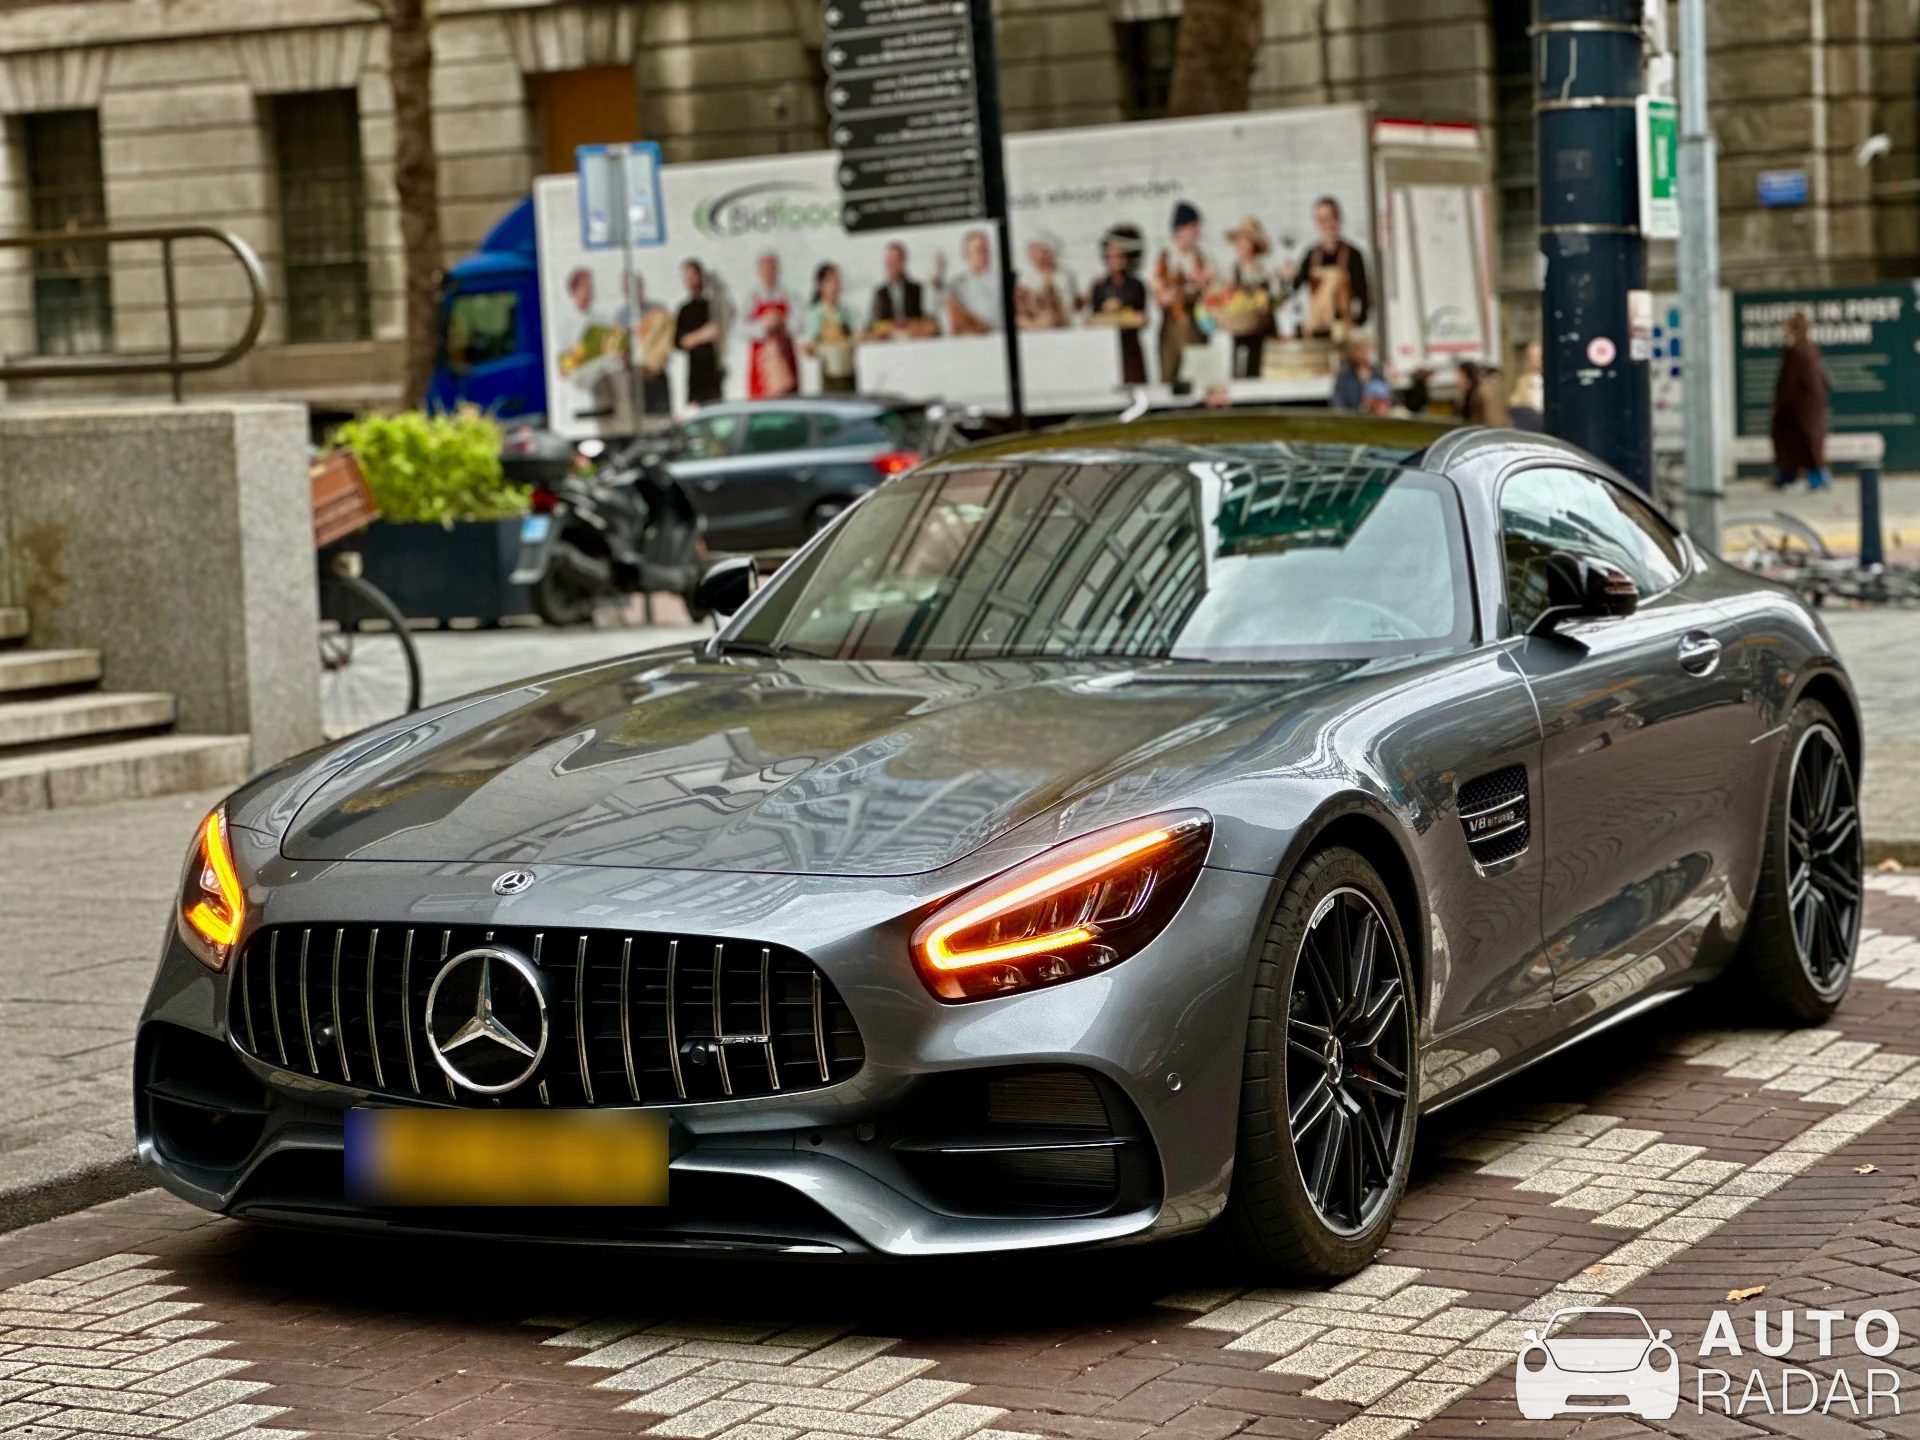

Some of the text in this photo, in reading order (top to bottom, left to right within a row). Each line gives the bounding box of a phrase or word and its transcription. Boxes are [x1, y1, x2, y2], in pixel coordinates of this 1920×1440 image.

[1742, 323, 1873, 347] ROTRDAM
[1469, 811, 1515, 831] V8 BITURBO
